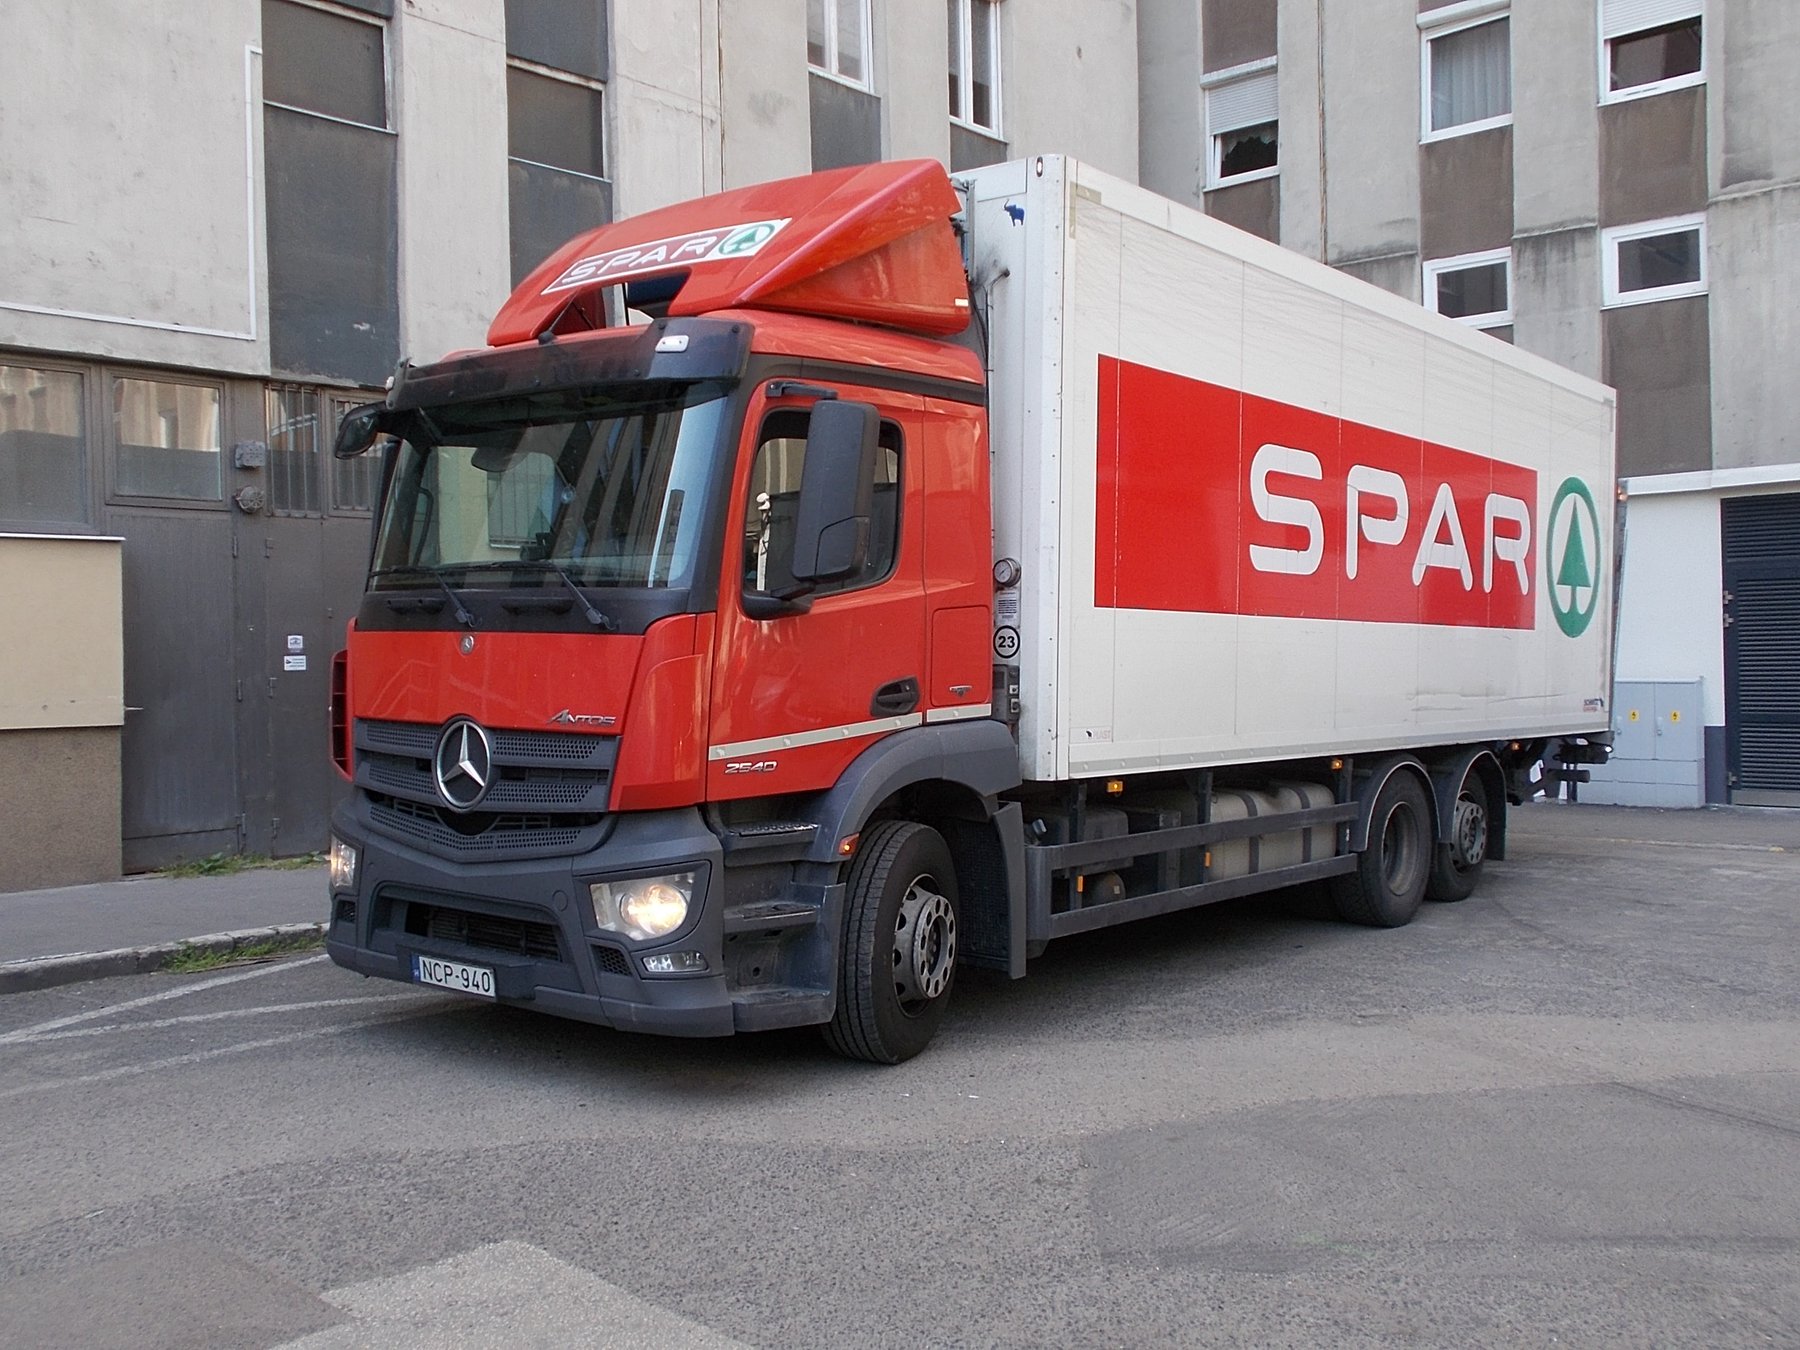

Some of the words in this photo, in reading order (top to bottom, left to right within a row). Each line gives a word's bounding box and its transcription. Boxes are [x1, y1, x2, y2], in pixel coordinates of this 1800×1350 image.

[562, 236, 717, 284] SPAR
[1249, 443, 1531, 595] SPAR
[998, 636, 1015, 648] 23
[546, 709, 616, 726] ANTOS
[725, 761, 777, 774] 2540
[422, 960, 491, 992] NCP-940
